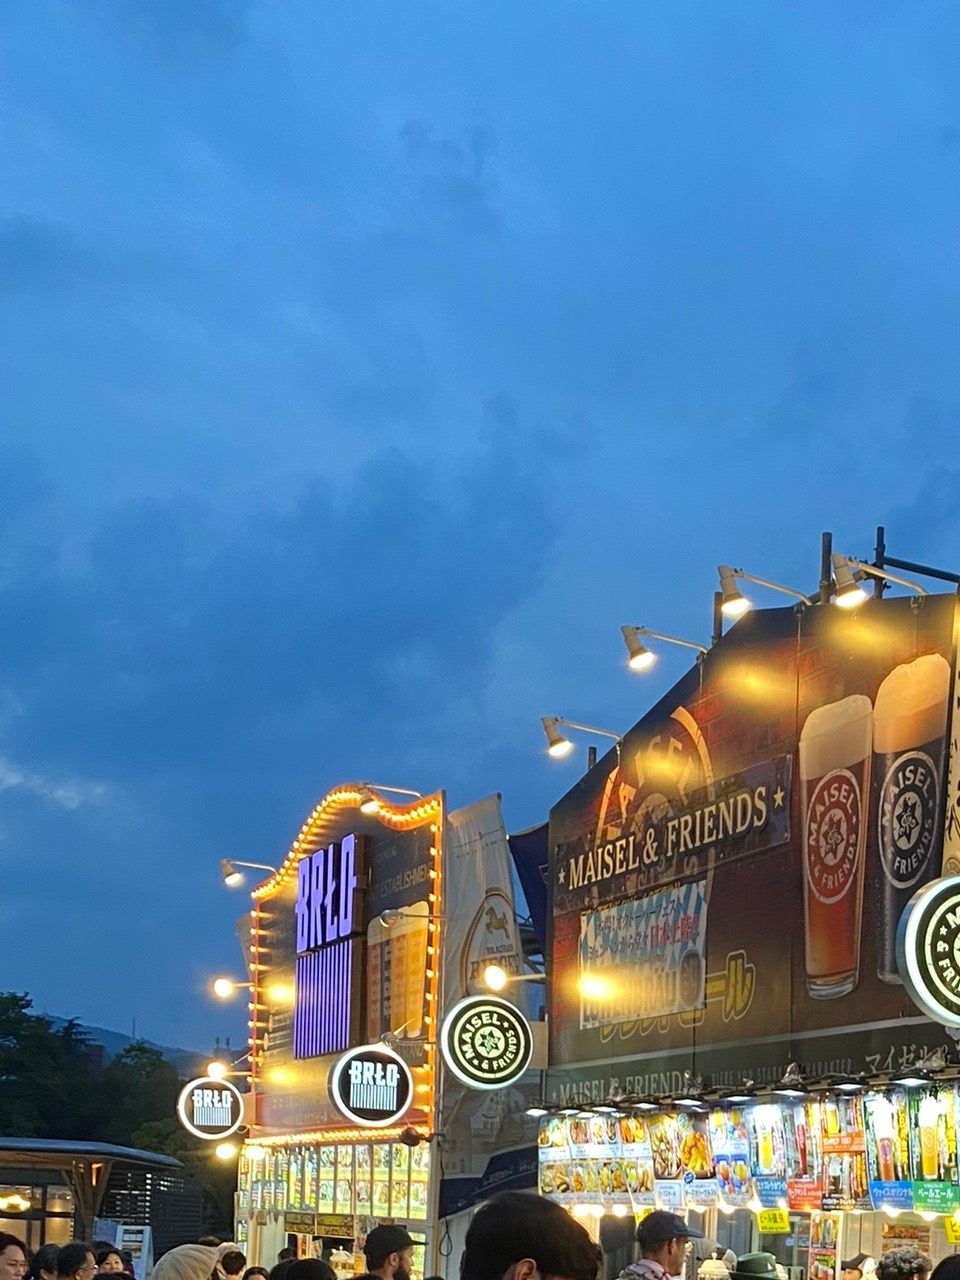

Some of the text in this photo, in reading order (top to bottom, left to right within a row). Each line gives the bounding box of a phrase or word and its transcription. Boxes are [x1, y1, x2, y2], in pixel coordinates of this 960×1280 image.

[568, 785, 767, 890] MAISEL & FRIENDS
[808, 782, 855, 846] MAISEL
[936, 940, 949, 953] &
[461, 1012, 518, 1071] MAISEL & FRIENDS
